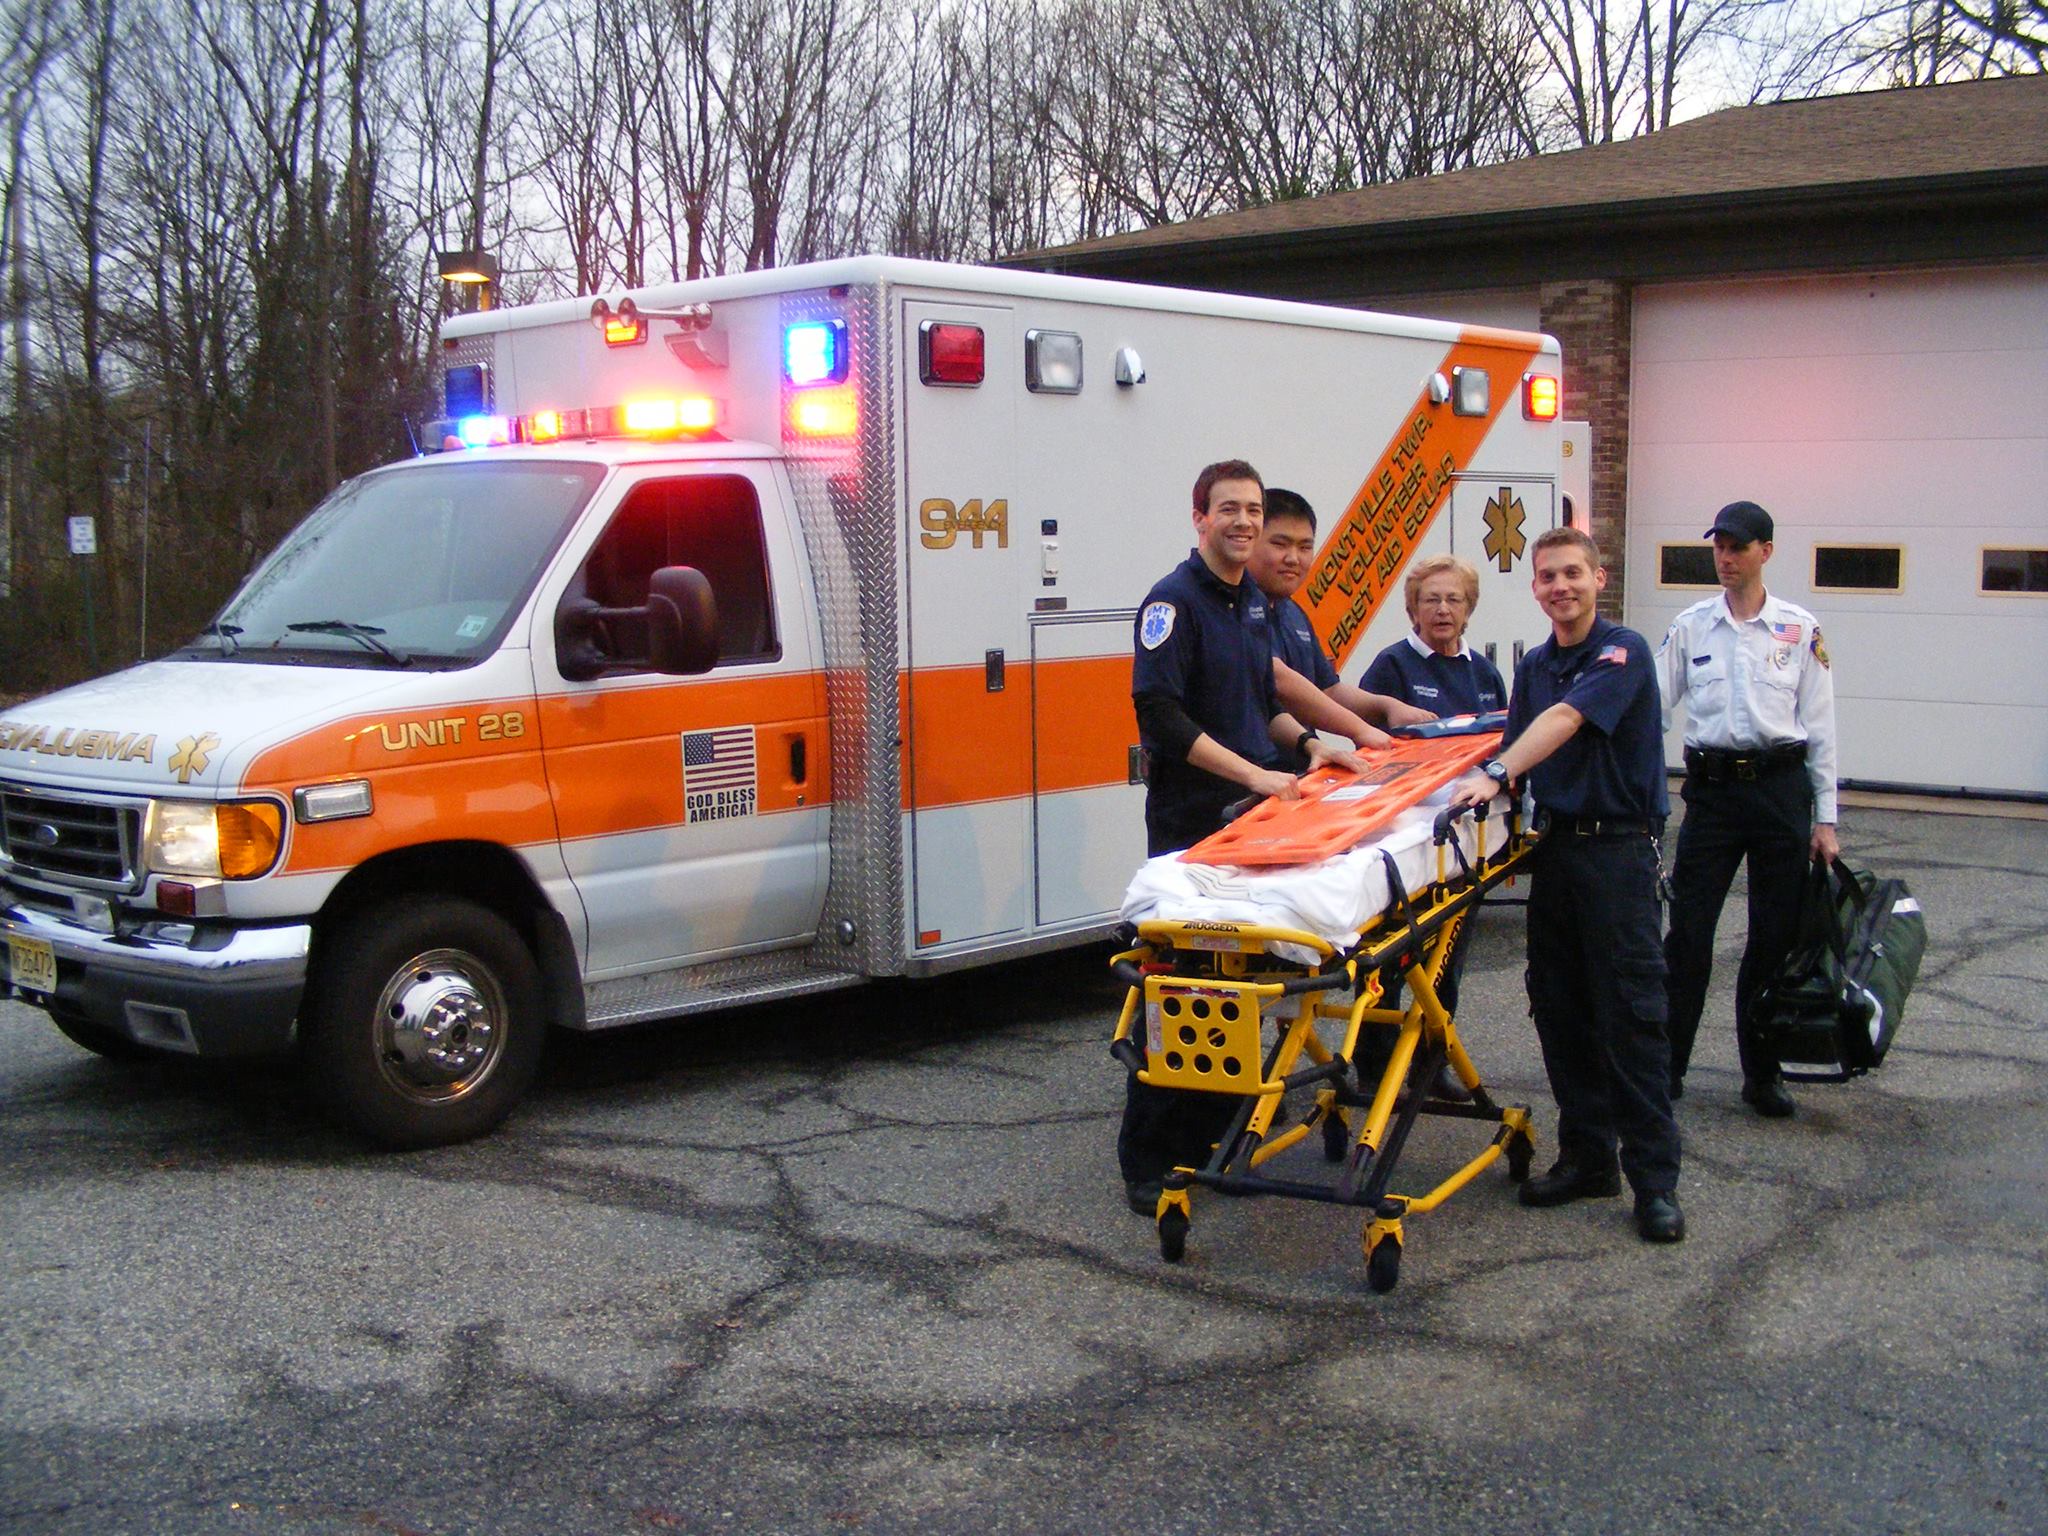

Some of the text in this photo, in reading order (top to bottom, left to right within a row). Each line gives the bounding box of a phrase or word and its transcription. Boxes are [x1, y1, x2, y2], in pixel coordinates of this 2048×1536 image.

[1307, 469, 1394, 607] MONTVILLE
[1337, 458, 1426, 596] VOLUNTEER
[1328, 450, 1455, 659] FIRST AID SQUAD
[1147, 605, 1171, 616] EMT
[381, 710, 525, 751] UNIT 28
[687, 787, 755, 809] GOD BLESS
[690, 802, 753, 823] AMERICA!
[1189, 922, 1233, 931] RUGGED
